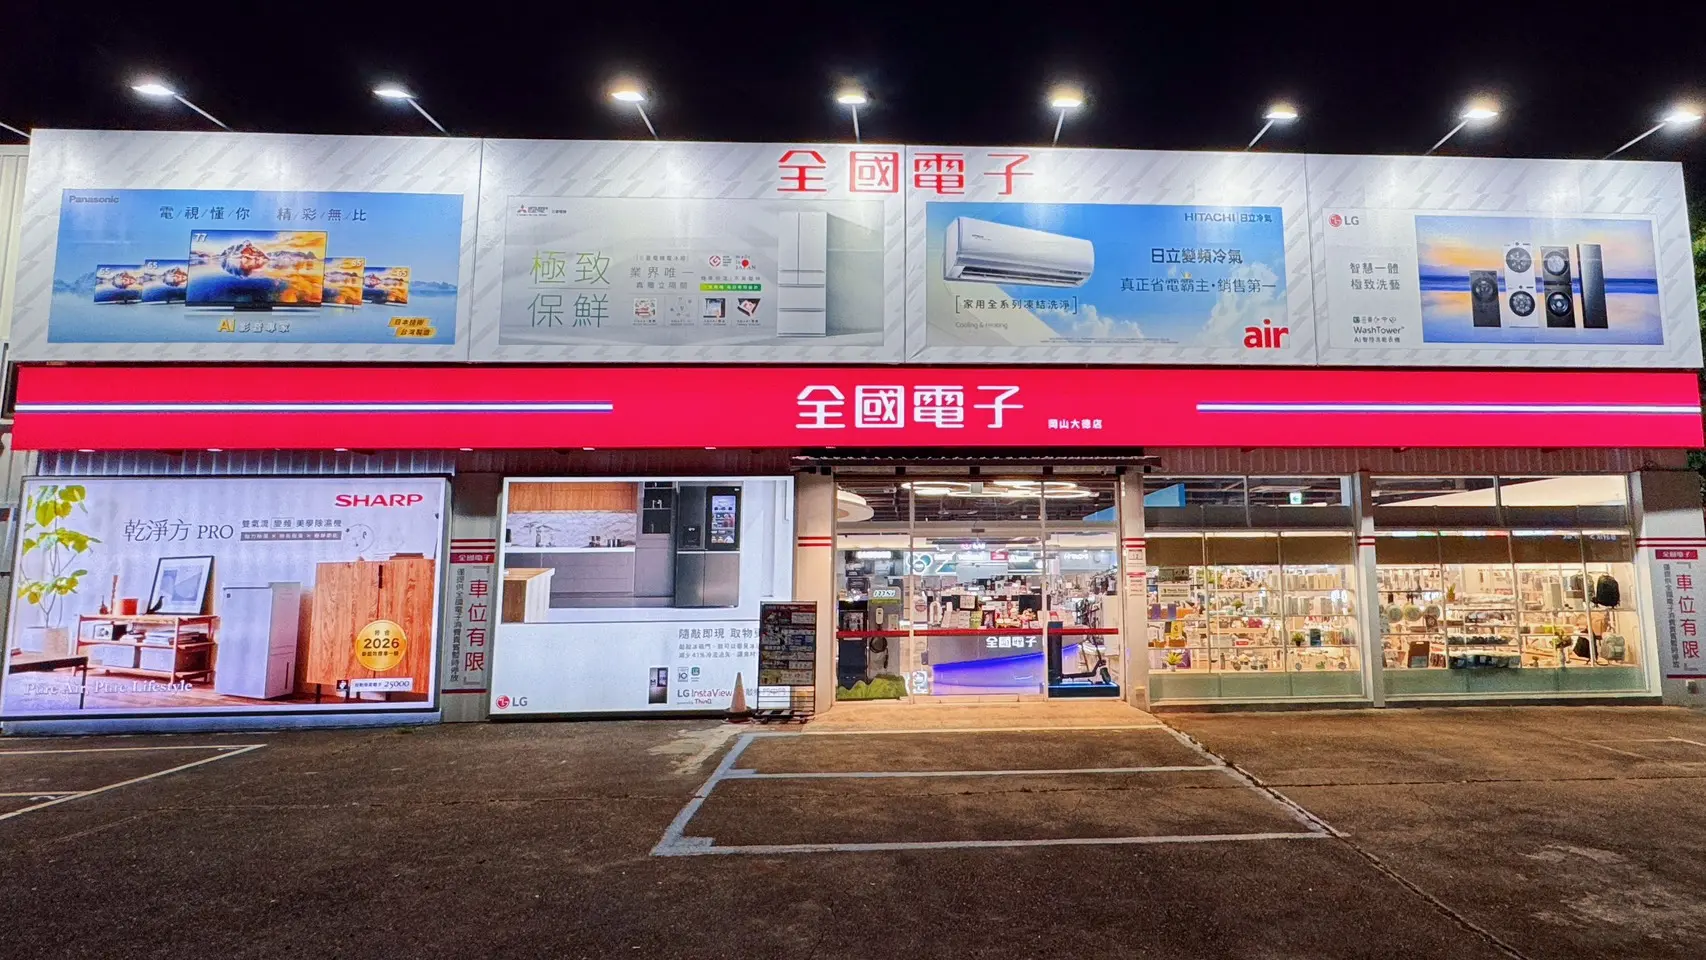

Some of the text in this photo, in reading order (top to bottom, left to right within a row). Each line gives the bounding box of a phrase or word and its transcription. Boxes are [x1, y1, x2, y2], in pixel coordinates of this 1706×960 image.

[777, 150, 1034, 195] 全國電子
[69, 195, 119, 203] Panasonic
[1184, 213, 1236, 222] HITACHI
[1344, 216, 1359, 225] LG
[195, 233, 207, 242] 77
[1151, 248, 1243, 264] 日立變頻冷氣
[530, 249, 610, 285] 極致
[630, 266, 694, 278] 業界唯一
[1350, 262, 1399, 274] 智慧一體
[527, 293, 609, 327] 保鮮
[218, 319, 236, 333] AI
[1244, 319, 1289, 348] air
[796, 385, 1024, 429] 全國電子
[335, 494, 423, 507] SHARP
[122, 518, 234, 541] 乾淨方 PRO
[363, 638, 400, 649] 2026
[986, 636, 1037, 648] 全國電子
[24, 683, 57, 695] Pure
[94, 681, 130, 694] Pure
[132, 679, 193, 695] Lifestyle
[384, 681, 410, 689] 25000
[677, 689, 690, 698] LG
[512, 696, 528, 707] LG
